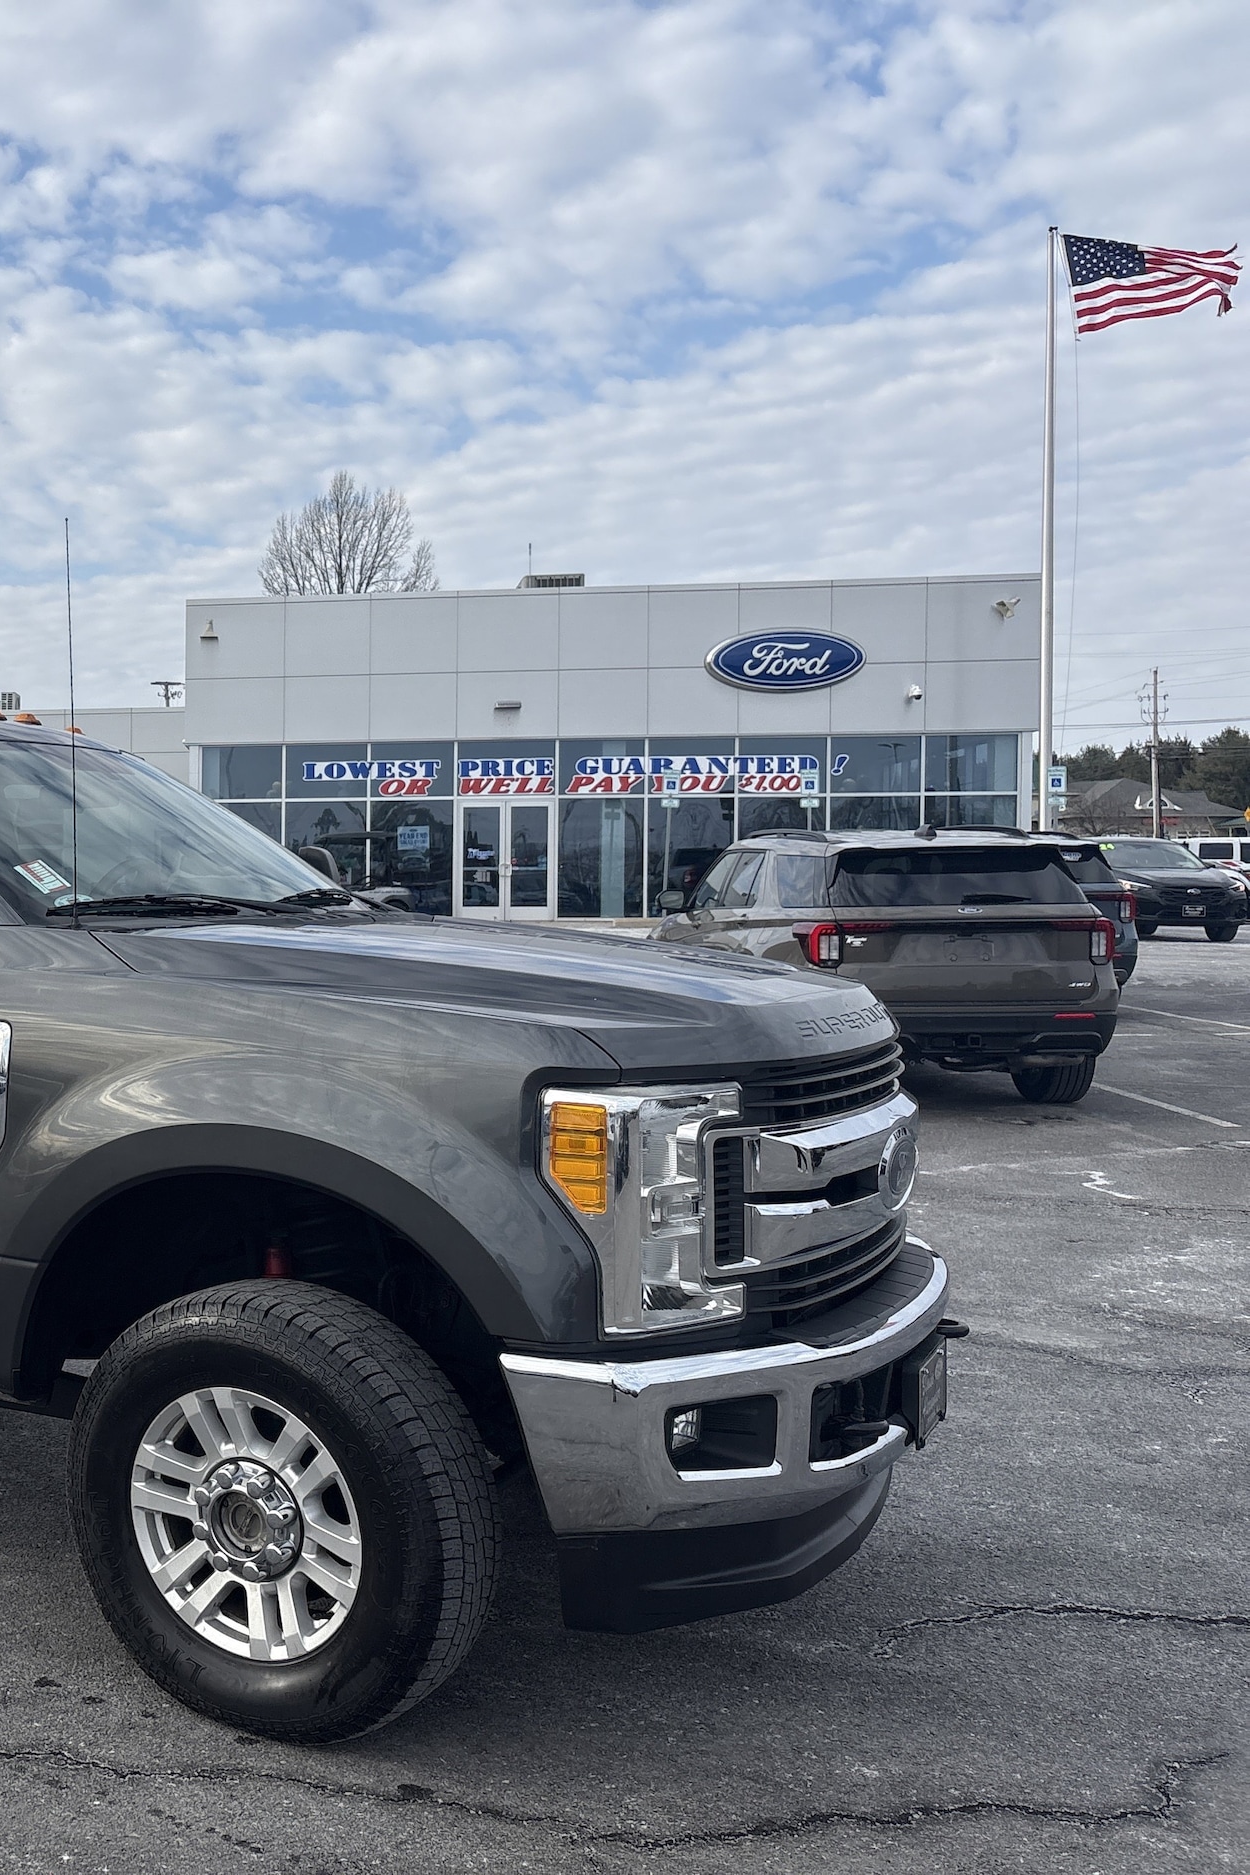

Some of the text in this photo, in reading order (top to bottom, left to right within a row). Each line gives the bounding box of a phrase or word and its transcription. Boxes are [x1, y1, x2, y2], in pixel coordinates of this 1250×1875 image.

[743, 642, 832, 676] Ford
[303, 760, 441, 780] LOWEST
[458, 758, 554, 777] PRICE
[575, 756, 819, 775] GUARANTEED
[379, 778, 432, 796] OR
[565, 775, 644, 793] PAY
